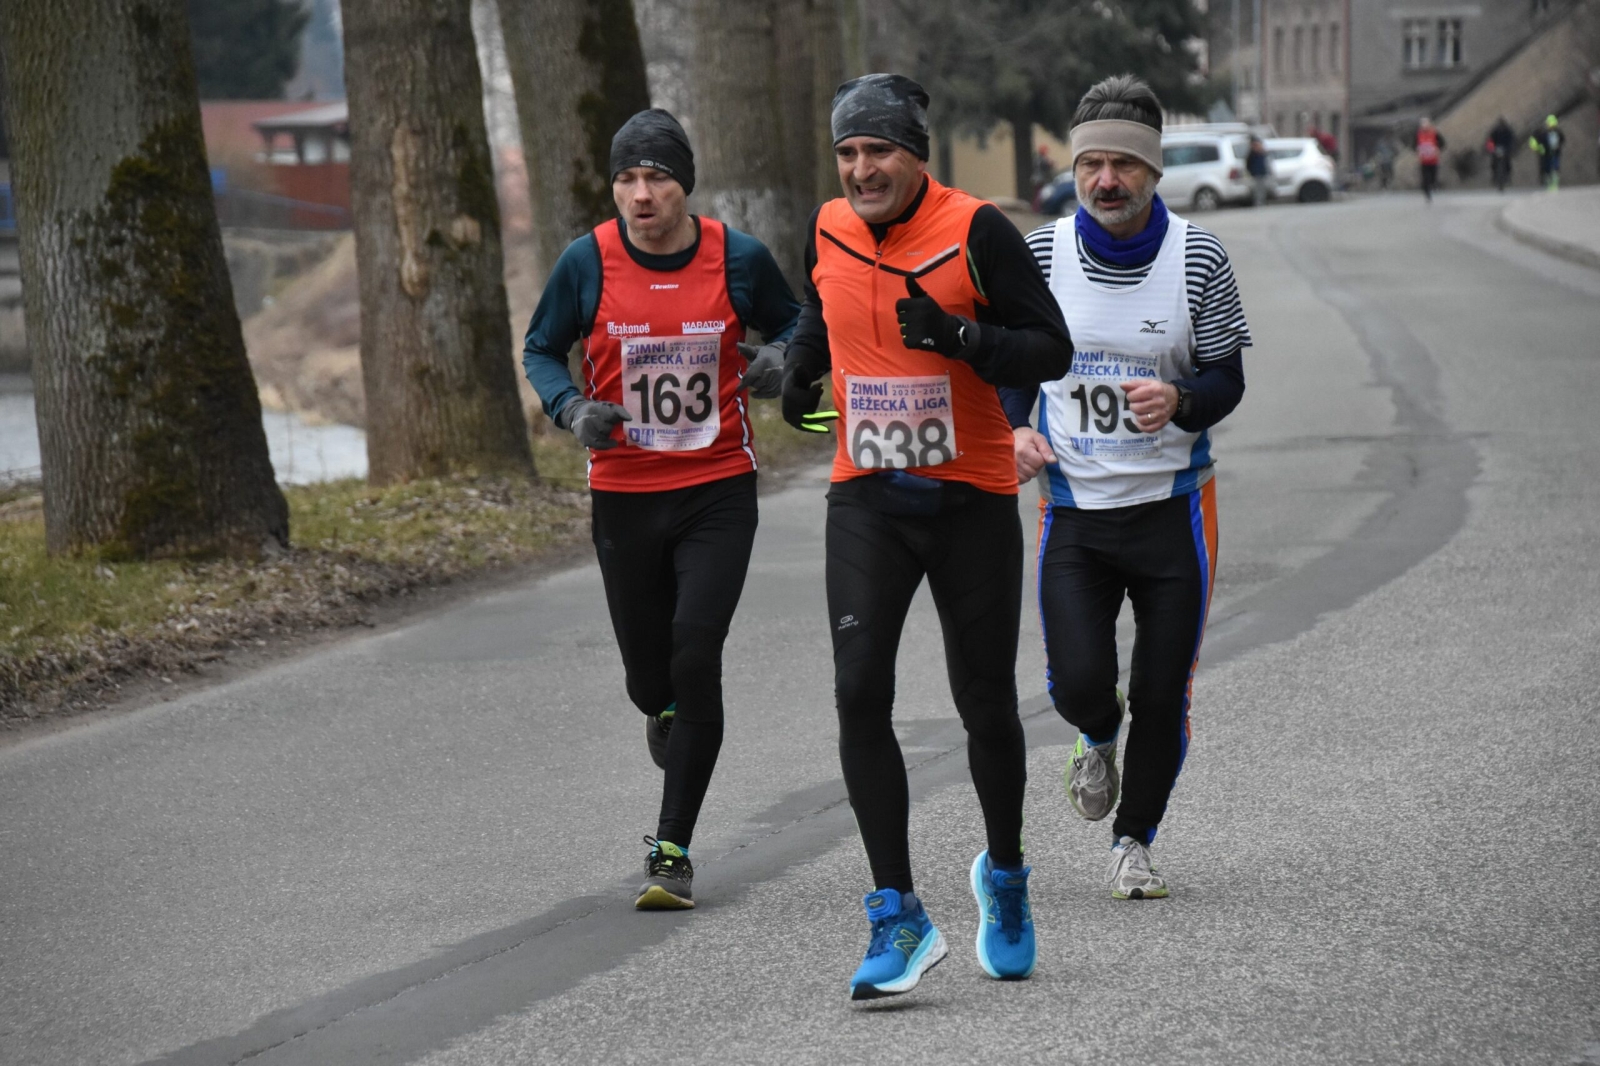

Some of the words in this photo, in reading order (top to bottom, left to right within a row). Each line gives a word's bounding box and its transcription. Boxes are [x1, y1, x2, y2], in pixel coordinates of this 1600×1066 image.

[607, 321, 650, 335] Krakonoš
[682, 320, 725, 330] MARATON
[627, 341, 666, 355] ZIMNÍ
[626, 352, 683, 366] BĚŽECKÁ
[689, 352, 717, 365] LIGA
[1073, 350, 1105, 362] IMNÍ
[1127, 366, 1156, 378] LIGA
[851, 382, 888, 396] ZIMNÍ
[630, 372, 713, 426] 163
[851, 396, 908, 411] BĚŽECKÁ
[915, 397, 948, 411] LIGA
[852, 417, 953, 469] 638
